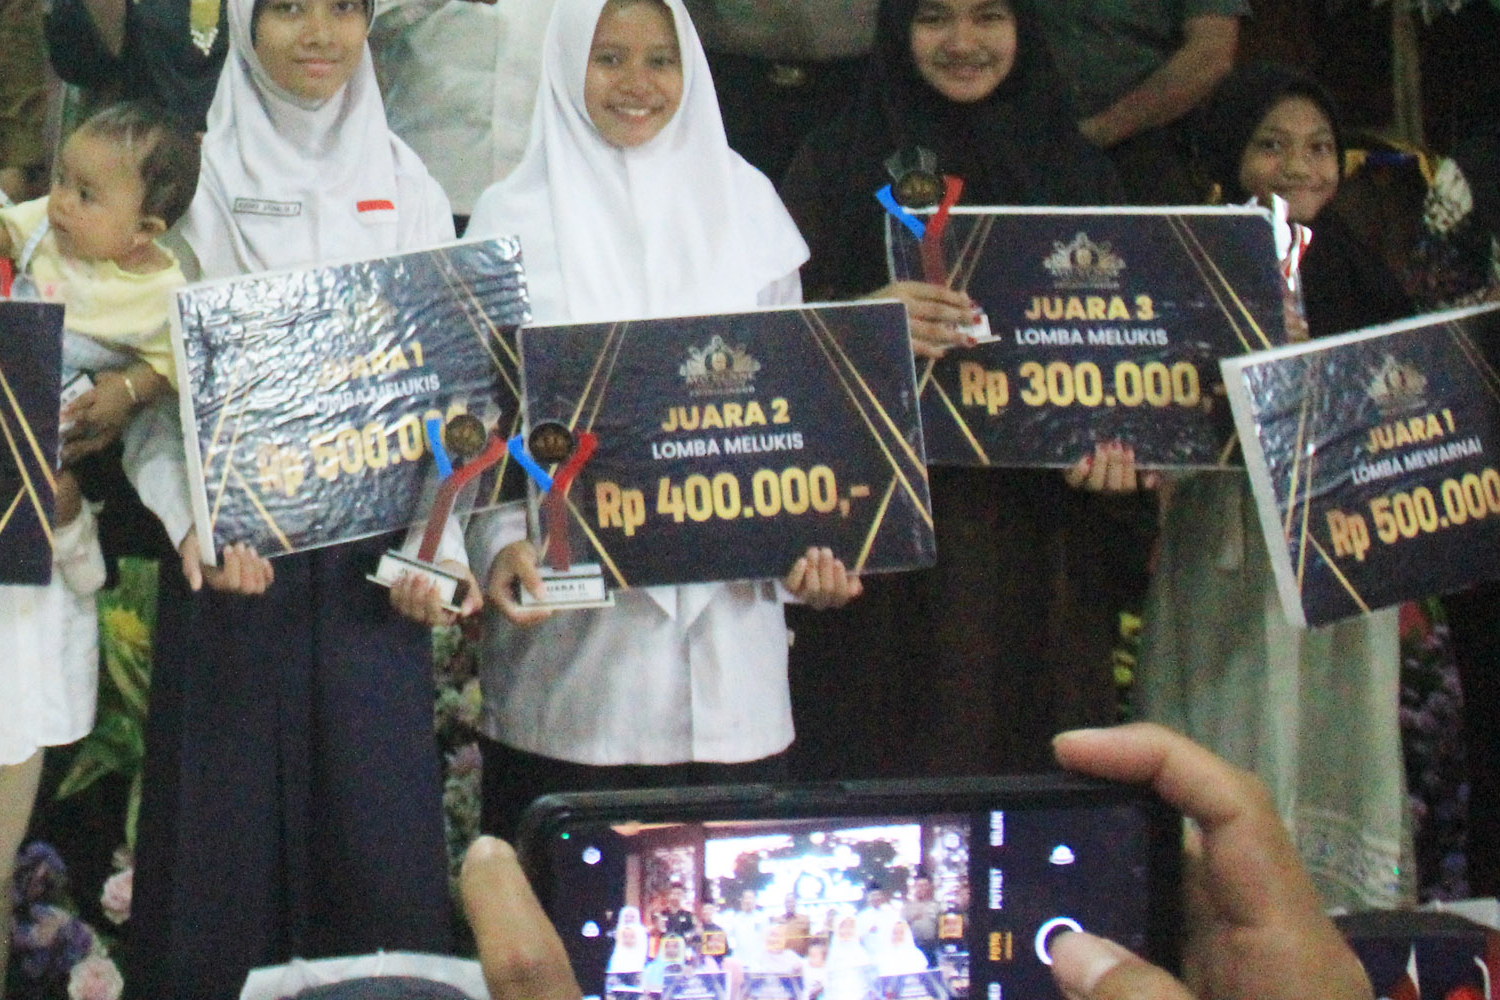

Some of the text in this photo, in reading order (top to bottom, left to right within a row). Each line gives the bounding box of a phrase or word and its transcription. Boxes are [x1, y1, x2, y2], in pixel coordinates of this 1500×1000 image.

[1023, 295, 1155, 321] JUARA 3
[411, 341, 425, 368] 1
[1014, 326, 1168, 346] LOMBA MELUKIS
[367, 373, 441, 401] MELUKIS
[959, 361, 1009, 415] Rp
[661, 397, 791, 433] JUARA 2
[1366, 408, 1456, 454] JUARA 1
[652, 431, 805, 461] LOMBA MELUKIS
[1350, 434, 1484, 485] LOMBA MEWARNAI
[255, 443, 305, 497] Rp
[596, 464, 871, 537] Rp 400.000,-
[1327, 508, 1371, 562] Rp
